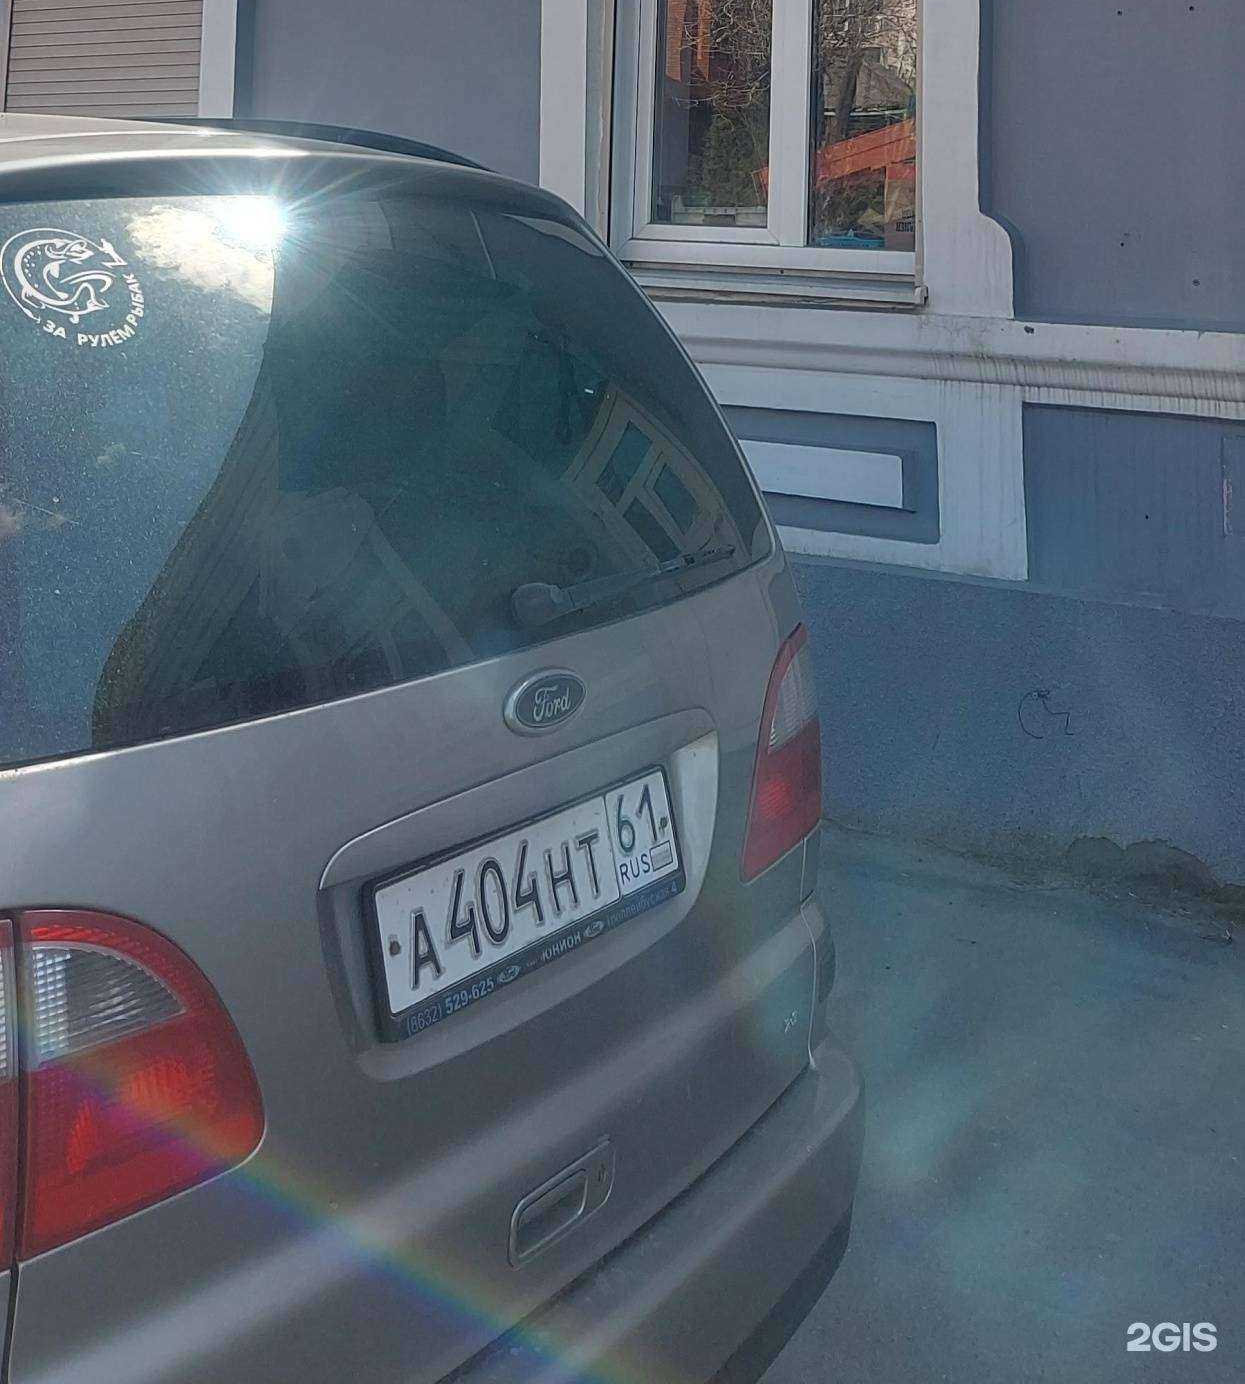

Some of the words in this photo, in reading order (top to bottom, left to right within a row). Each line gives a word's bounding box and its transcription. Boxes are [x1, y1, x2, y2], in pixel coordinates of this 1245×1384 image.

[42, 319, 67, 339] ЗА
[122, 272, 145, 327] РЫБАК
[533, 684, 572, 722] Ford
[614, 783, 660, 855] 61
[619, 853, 651, 885] RUS
[406, 1001, 442, 1037] (8632)
[445, 976, 495, 1015] 529-625
